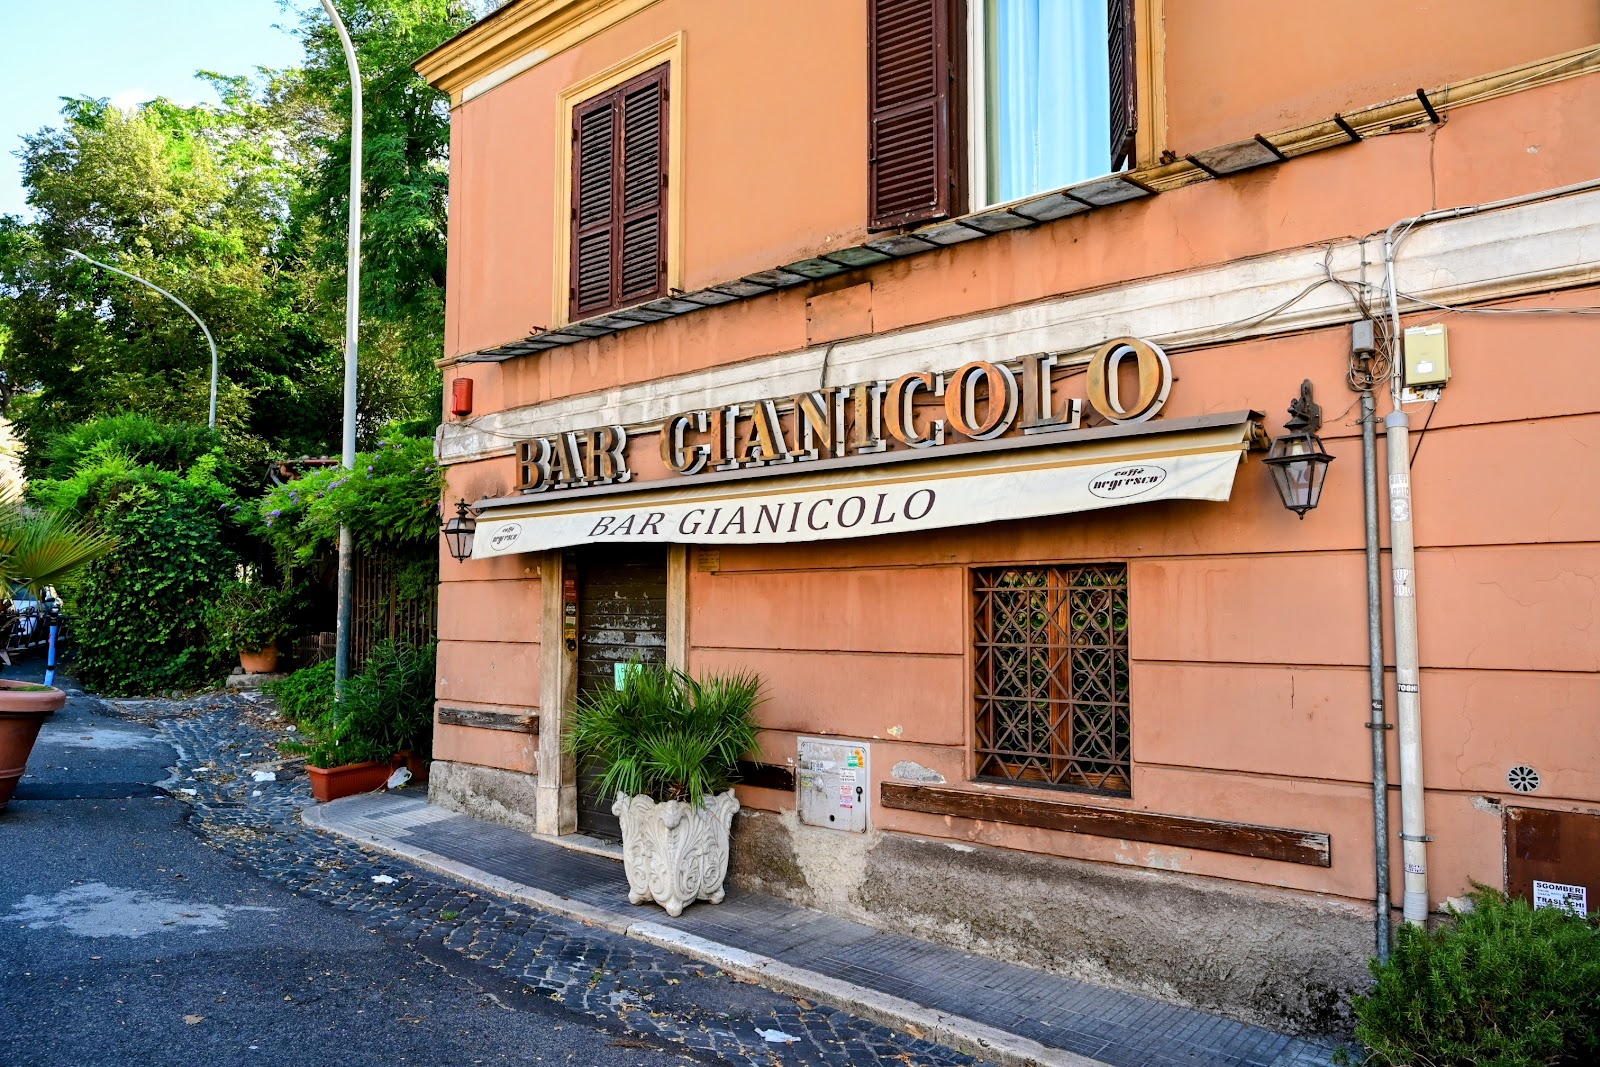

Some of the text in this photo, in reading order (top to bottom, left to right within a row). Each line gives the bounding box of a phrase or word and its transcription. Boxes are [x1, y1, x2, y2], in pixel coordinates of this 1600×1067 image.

[513, 337, 1173, 494] BAR GIANICOLO
[587, 488, 936, 538] BAR GIANICOLO
[1536, 882, 1584, 894] SGOMBERI
[1537, 897, 1584, 908] TRASLOCHI
